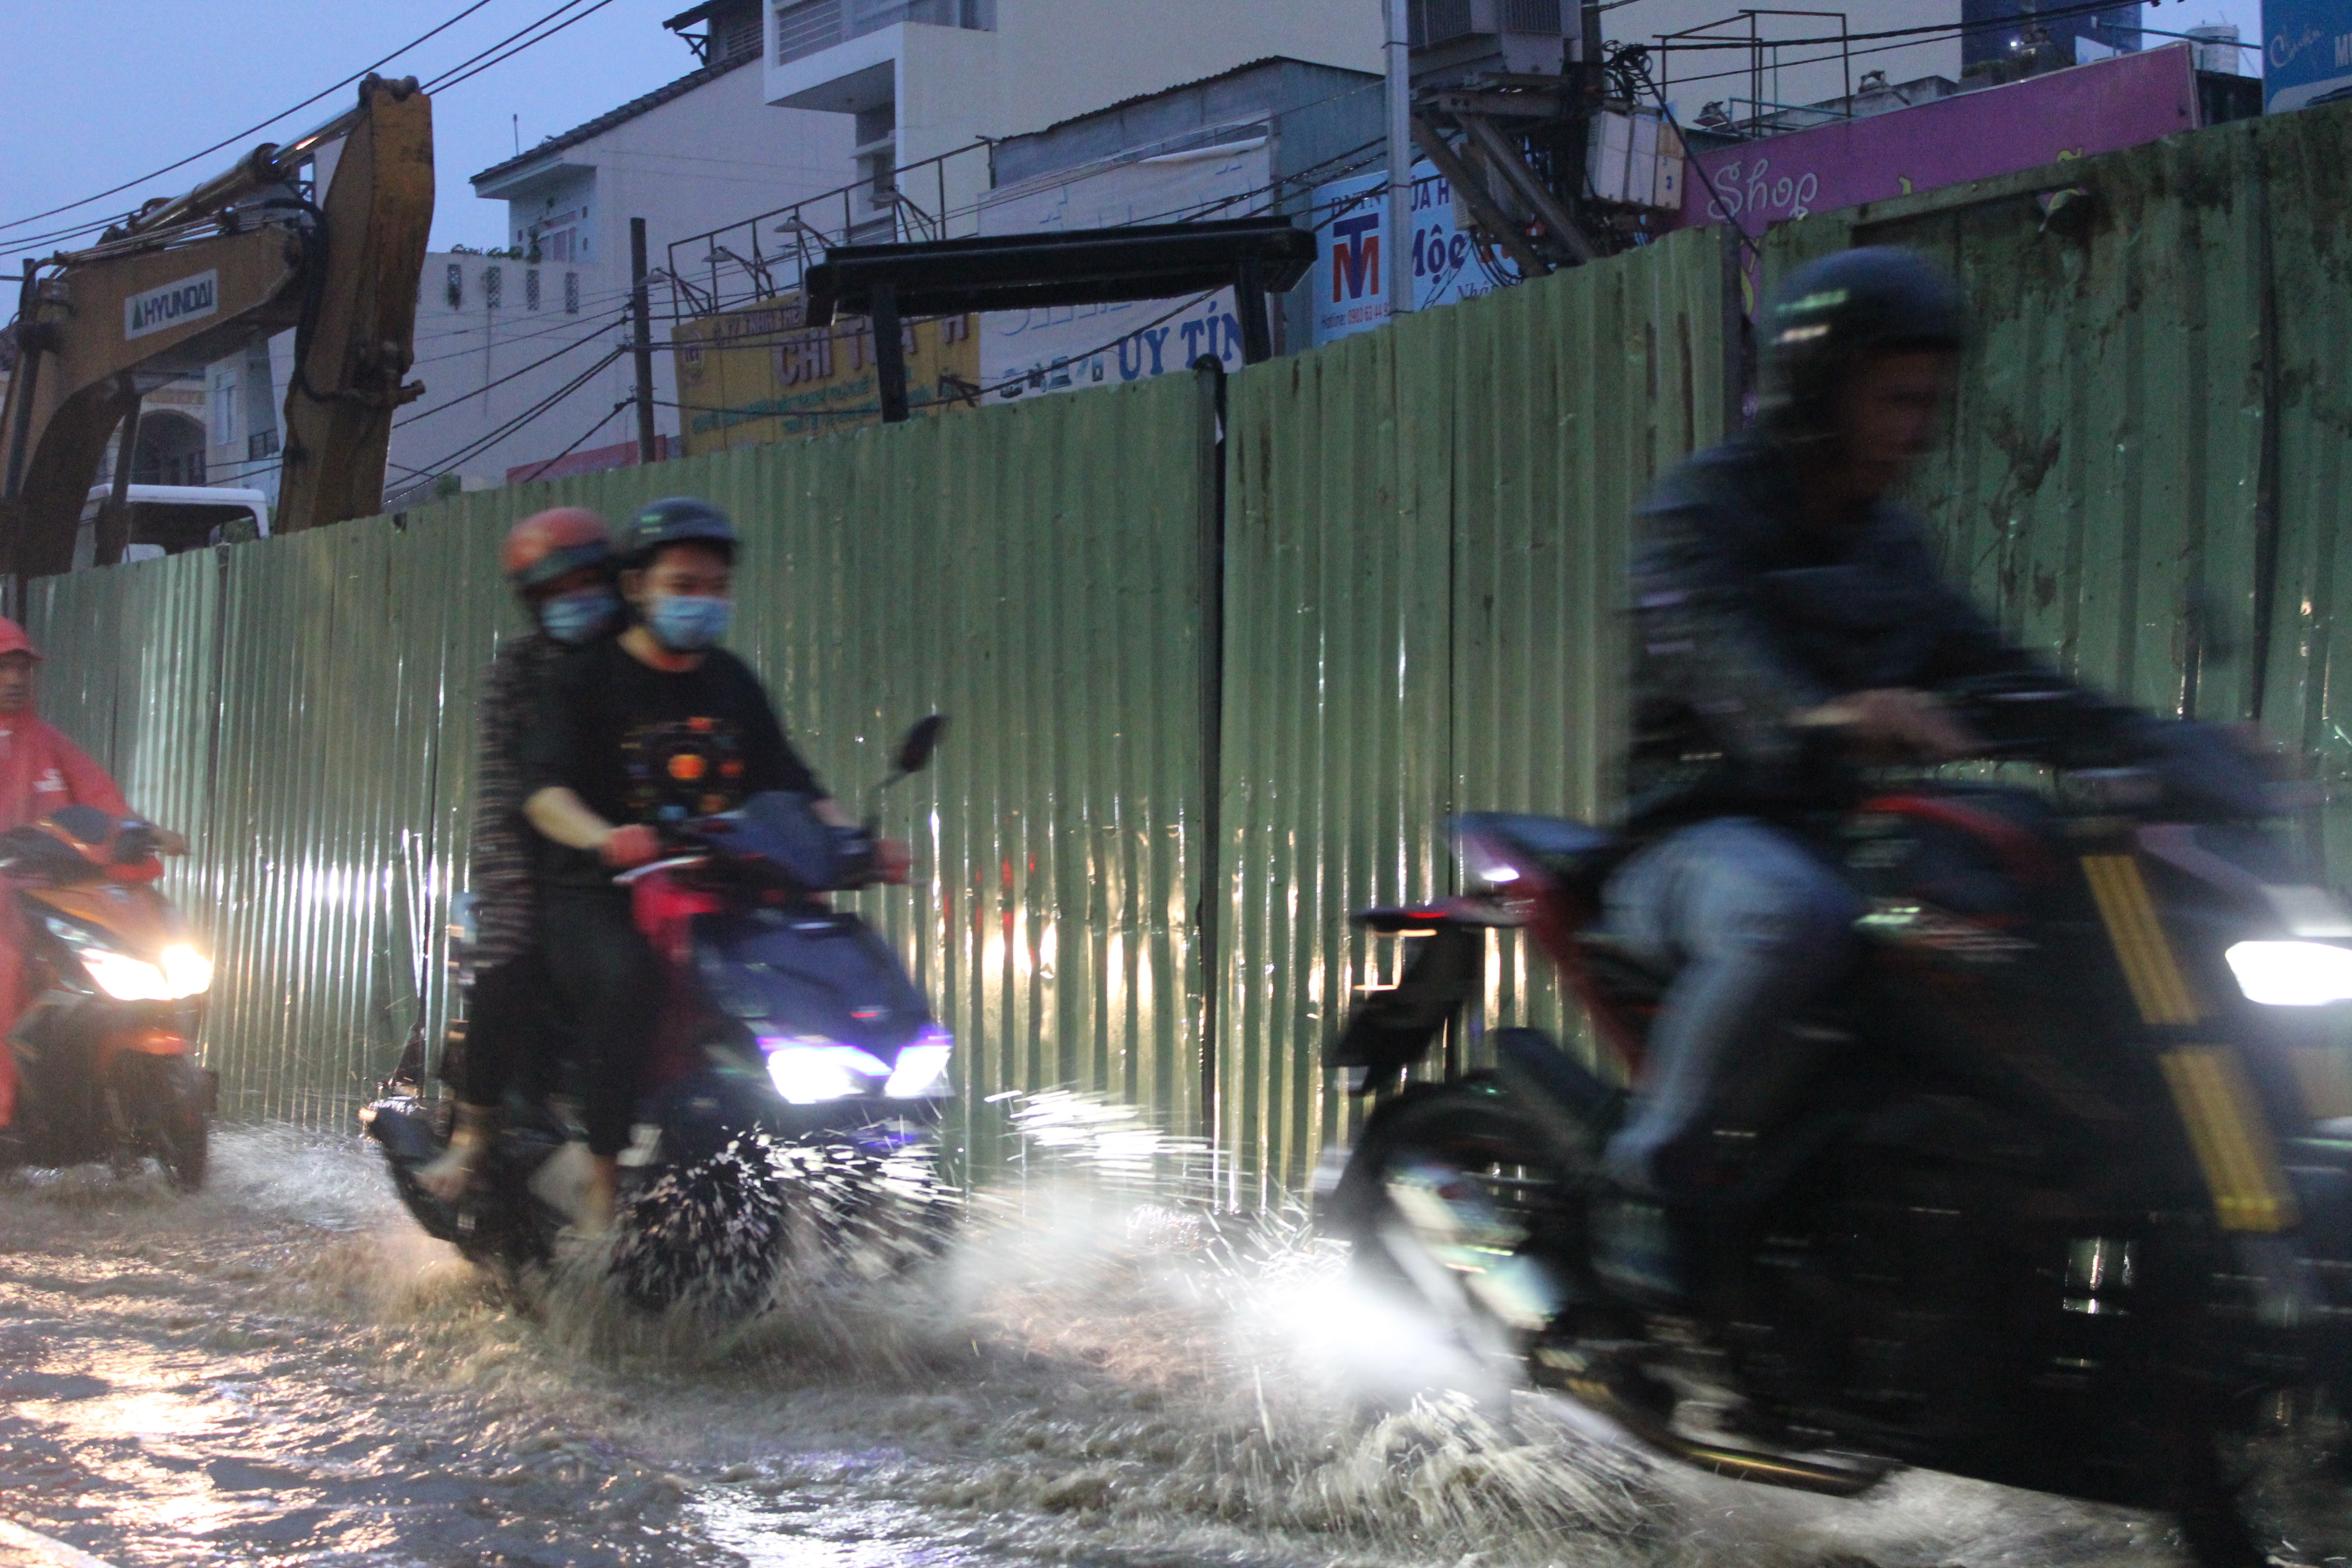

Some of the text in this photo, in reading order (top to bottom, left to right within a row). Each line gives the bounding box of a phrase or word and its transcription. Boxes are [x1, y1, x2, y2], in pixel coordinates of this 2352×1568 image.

[1708, 158, 1817, 220] Shop
[144, 279, 212, 325] HYUNDAI
[1118, 327, 1170, 381] UY
